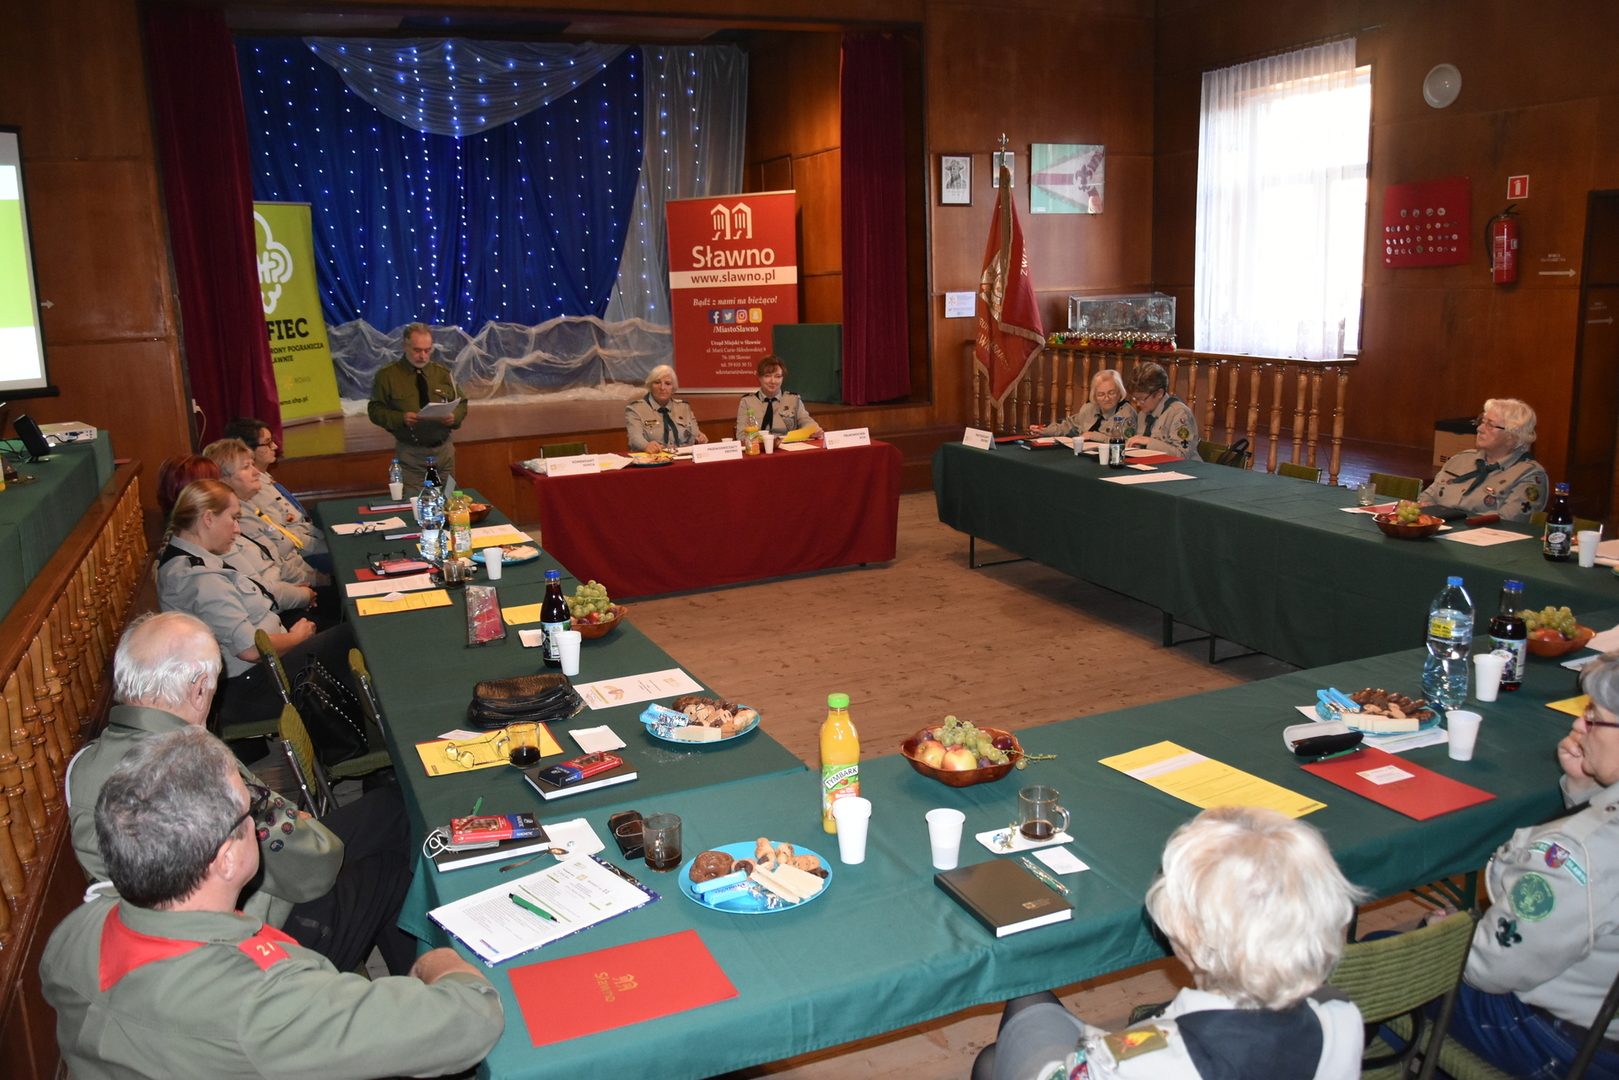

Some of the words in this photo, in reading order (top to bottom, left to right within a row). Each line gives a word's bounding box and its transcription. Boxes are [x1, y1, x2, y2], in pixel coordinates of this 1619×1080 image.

[692, 246, 775, 268] Sławno
[691, 270, 776, 284] www.slawno.pl
[693, 297, 710, 307] Bądź
[718, 297, 736, 305] nami
[288, 342, 324, 352] POGRANICZA
[826, 766, 857, 786] TYMBARK
[256, 942, 275, 956] 21
[594, 972, 616, 1002] Sławno
